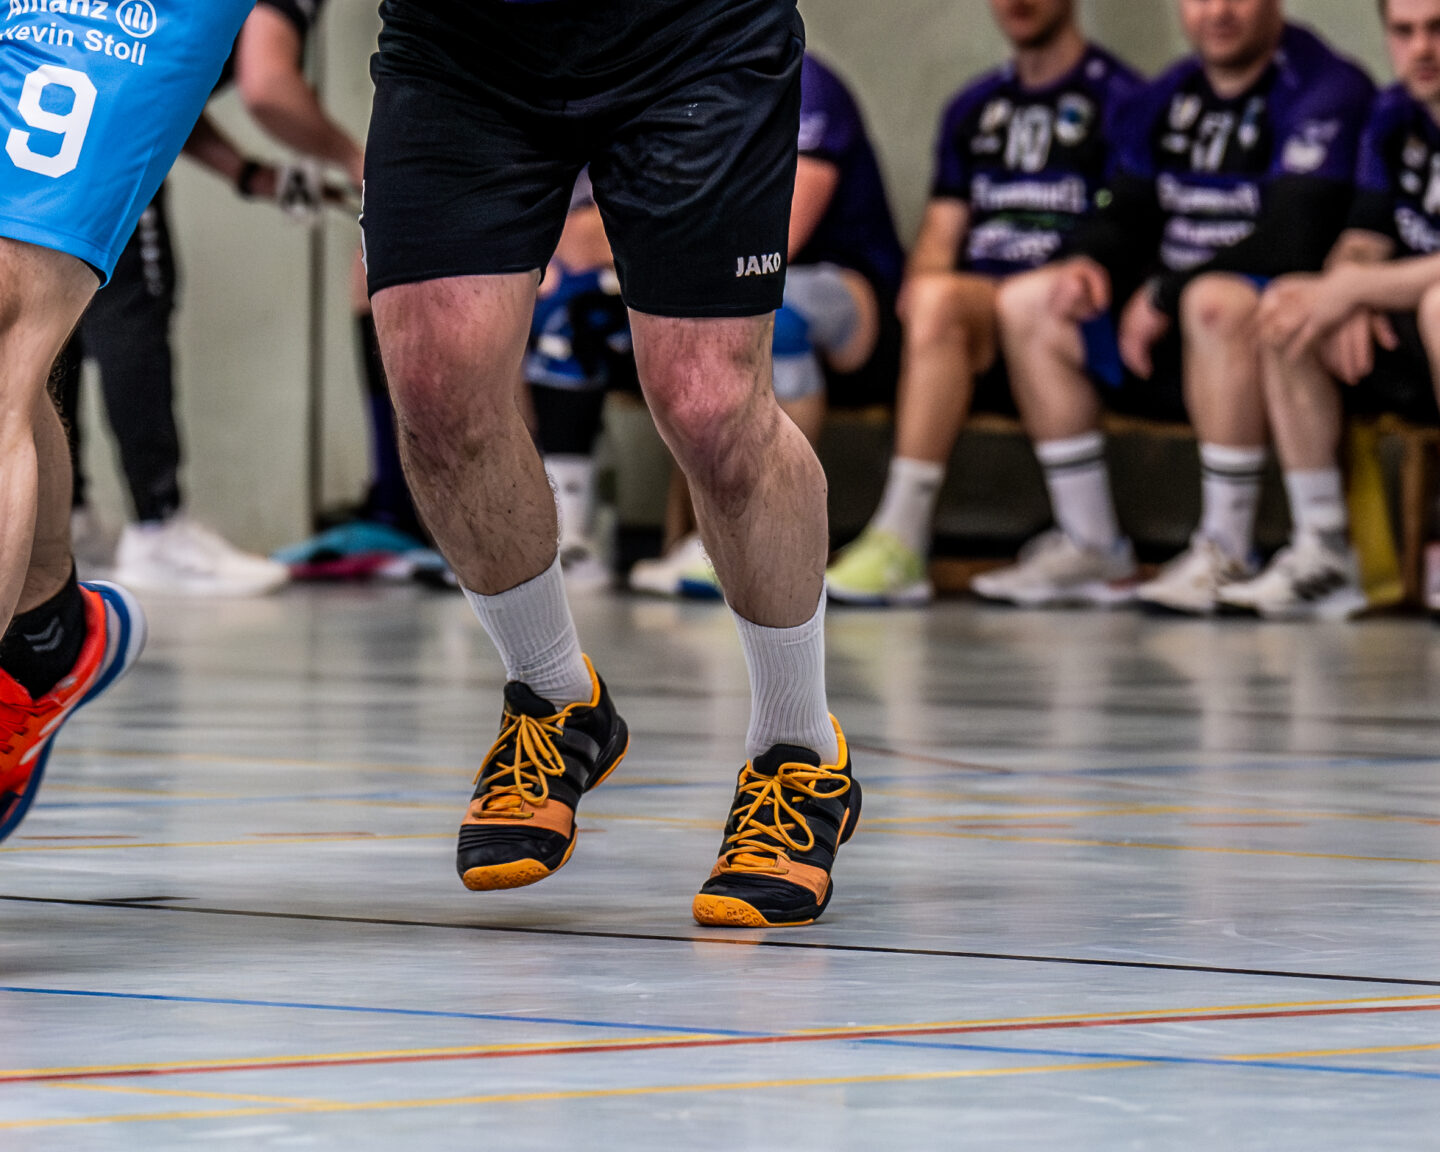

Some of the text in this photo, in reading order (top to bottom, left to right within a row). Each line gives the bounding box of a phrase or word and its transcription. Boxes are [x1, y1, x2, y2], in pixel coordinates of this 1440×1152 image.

[84, 29, 147, 66] Stoll
[5, 64, 98, 178] 9
[735, 252, 782, 278] JAKO
